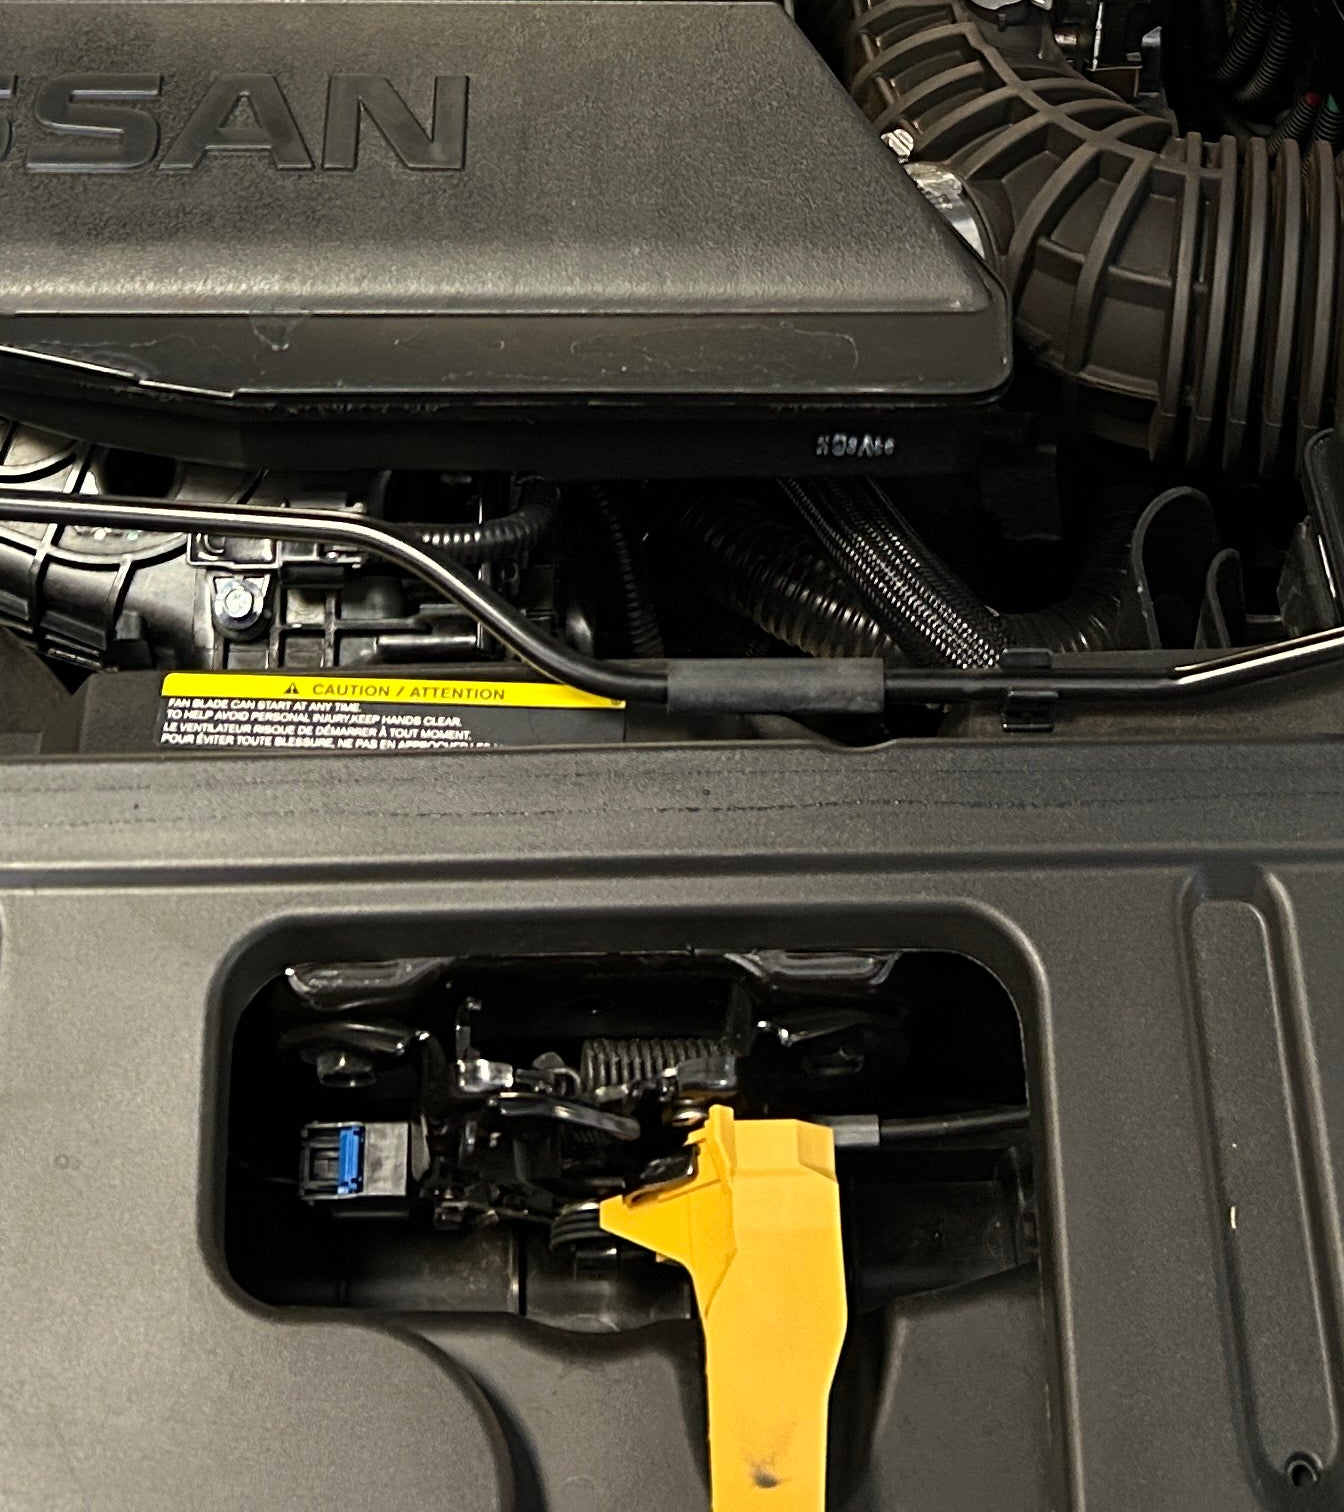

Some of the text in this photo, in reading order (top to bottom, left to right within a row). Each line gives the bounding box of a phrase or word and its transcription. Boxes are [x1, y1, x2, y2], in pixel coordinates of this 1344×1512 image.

[313, 683, 505, 700] CAUTION / ATTENTION
[168, 698, 191, 708] FAN
[192, 699, 229, 709] BLADE
[230, 699, 256, 710] CAN
[257, 700, 291, 710] START
[292, 701, 307, 711] AT
[308, 702, 332, 711] ANY
[167, 709, 182, 719] TO
[183, 709, 214, 720] HELP
[214, 710, 250, 721] AVOID
[250, 712, 310, 723] PERSONAL
[381, 715, 422, 726] HANDS
[163, 722, 177, 732] LE
[179, 723, 251, 734] VENTILATEUR
[253, 724, 295, 735] RISQUE
[297, 725, 313, 735] DE
[315, 724, 377, 737] DÉMARRER
[379, 725, 388, 737] À
[390, 728, 419, 738] TOUT
[160, 733, 195, 744] POUR
[195, 732, 236, 745] ÉVITER
[236, 735, 273, 746] TOUTE
[337, 738, 353, 748] NE
[355, 739, 377, 748] PAS
[379, 739, 395, 749] EN
